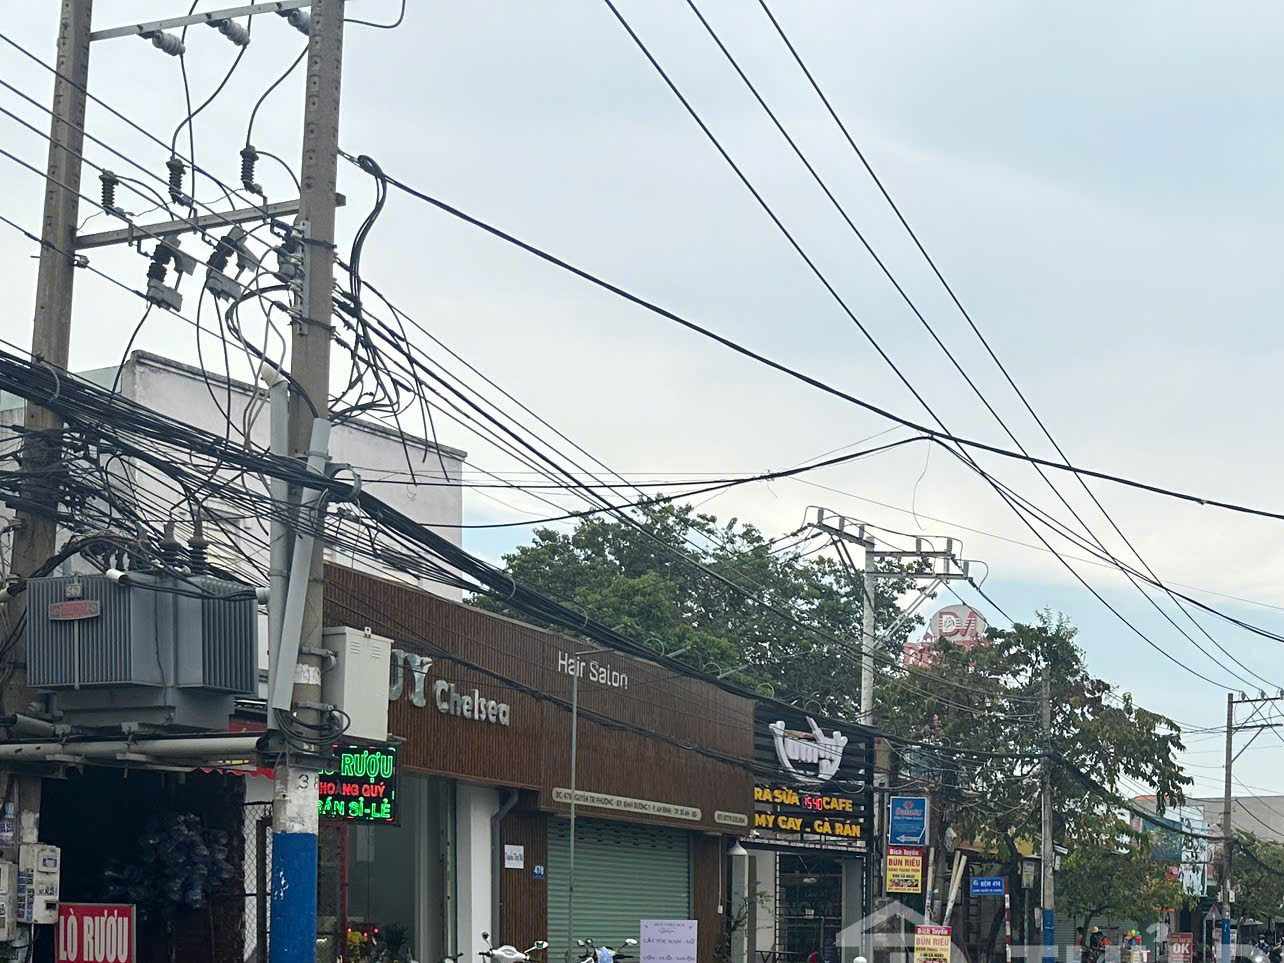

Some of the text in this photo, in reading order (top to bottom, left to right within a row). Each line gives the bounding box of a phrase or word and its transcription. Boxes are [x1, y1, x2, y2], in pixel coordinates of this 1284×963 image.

[558, 650, 628, 689] Hair Salon
[435, 679, 510, 726] Chelsea
[341, 749, 393, 783] RƯỢU
[319, 781, 359, 796] HONG
[822, 796, 853, 812] CAFE
[813, 817, 832, 834] GÀ
[835, 820, 861, 838] RÁN
[59, 907, 78, 961] LÒ
[1172, 943, 1190, 954] OK
